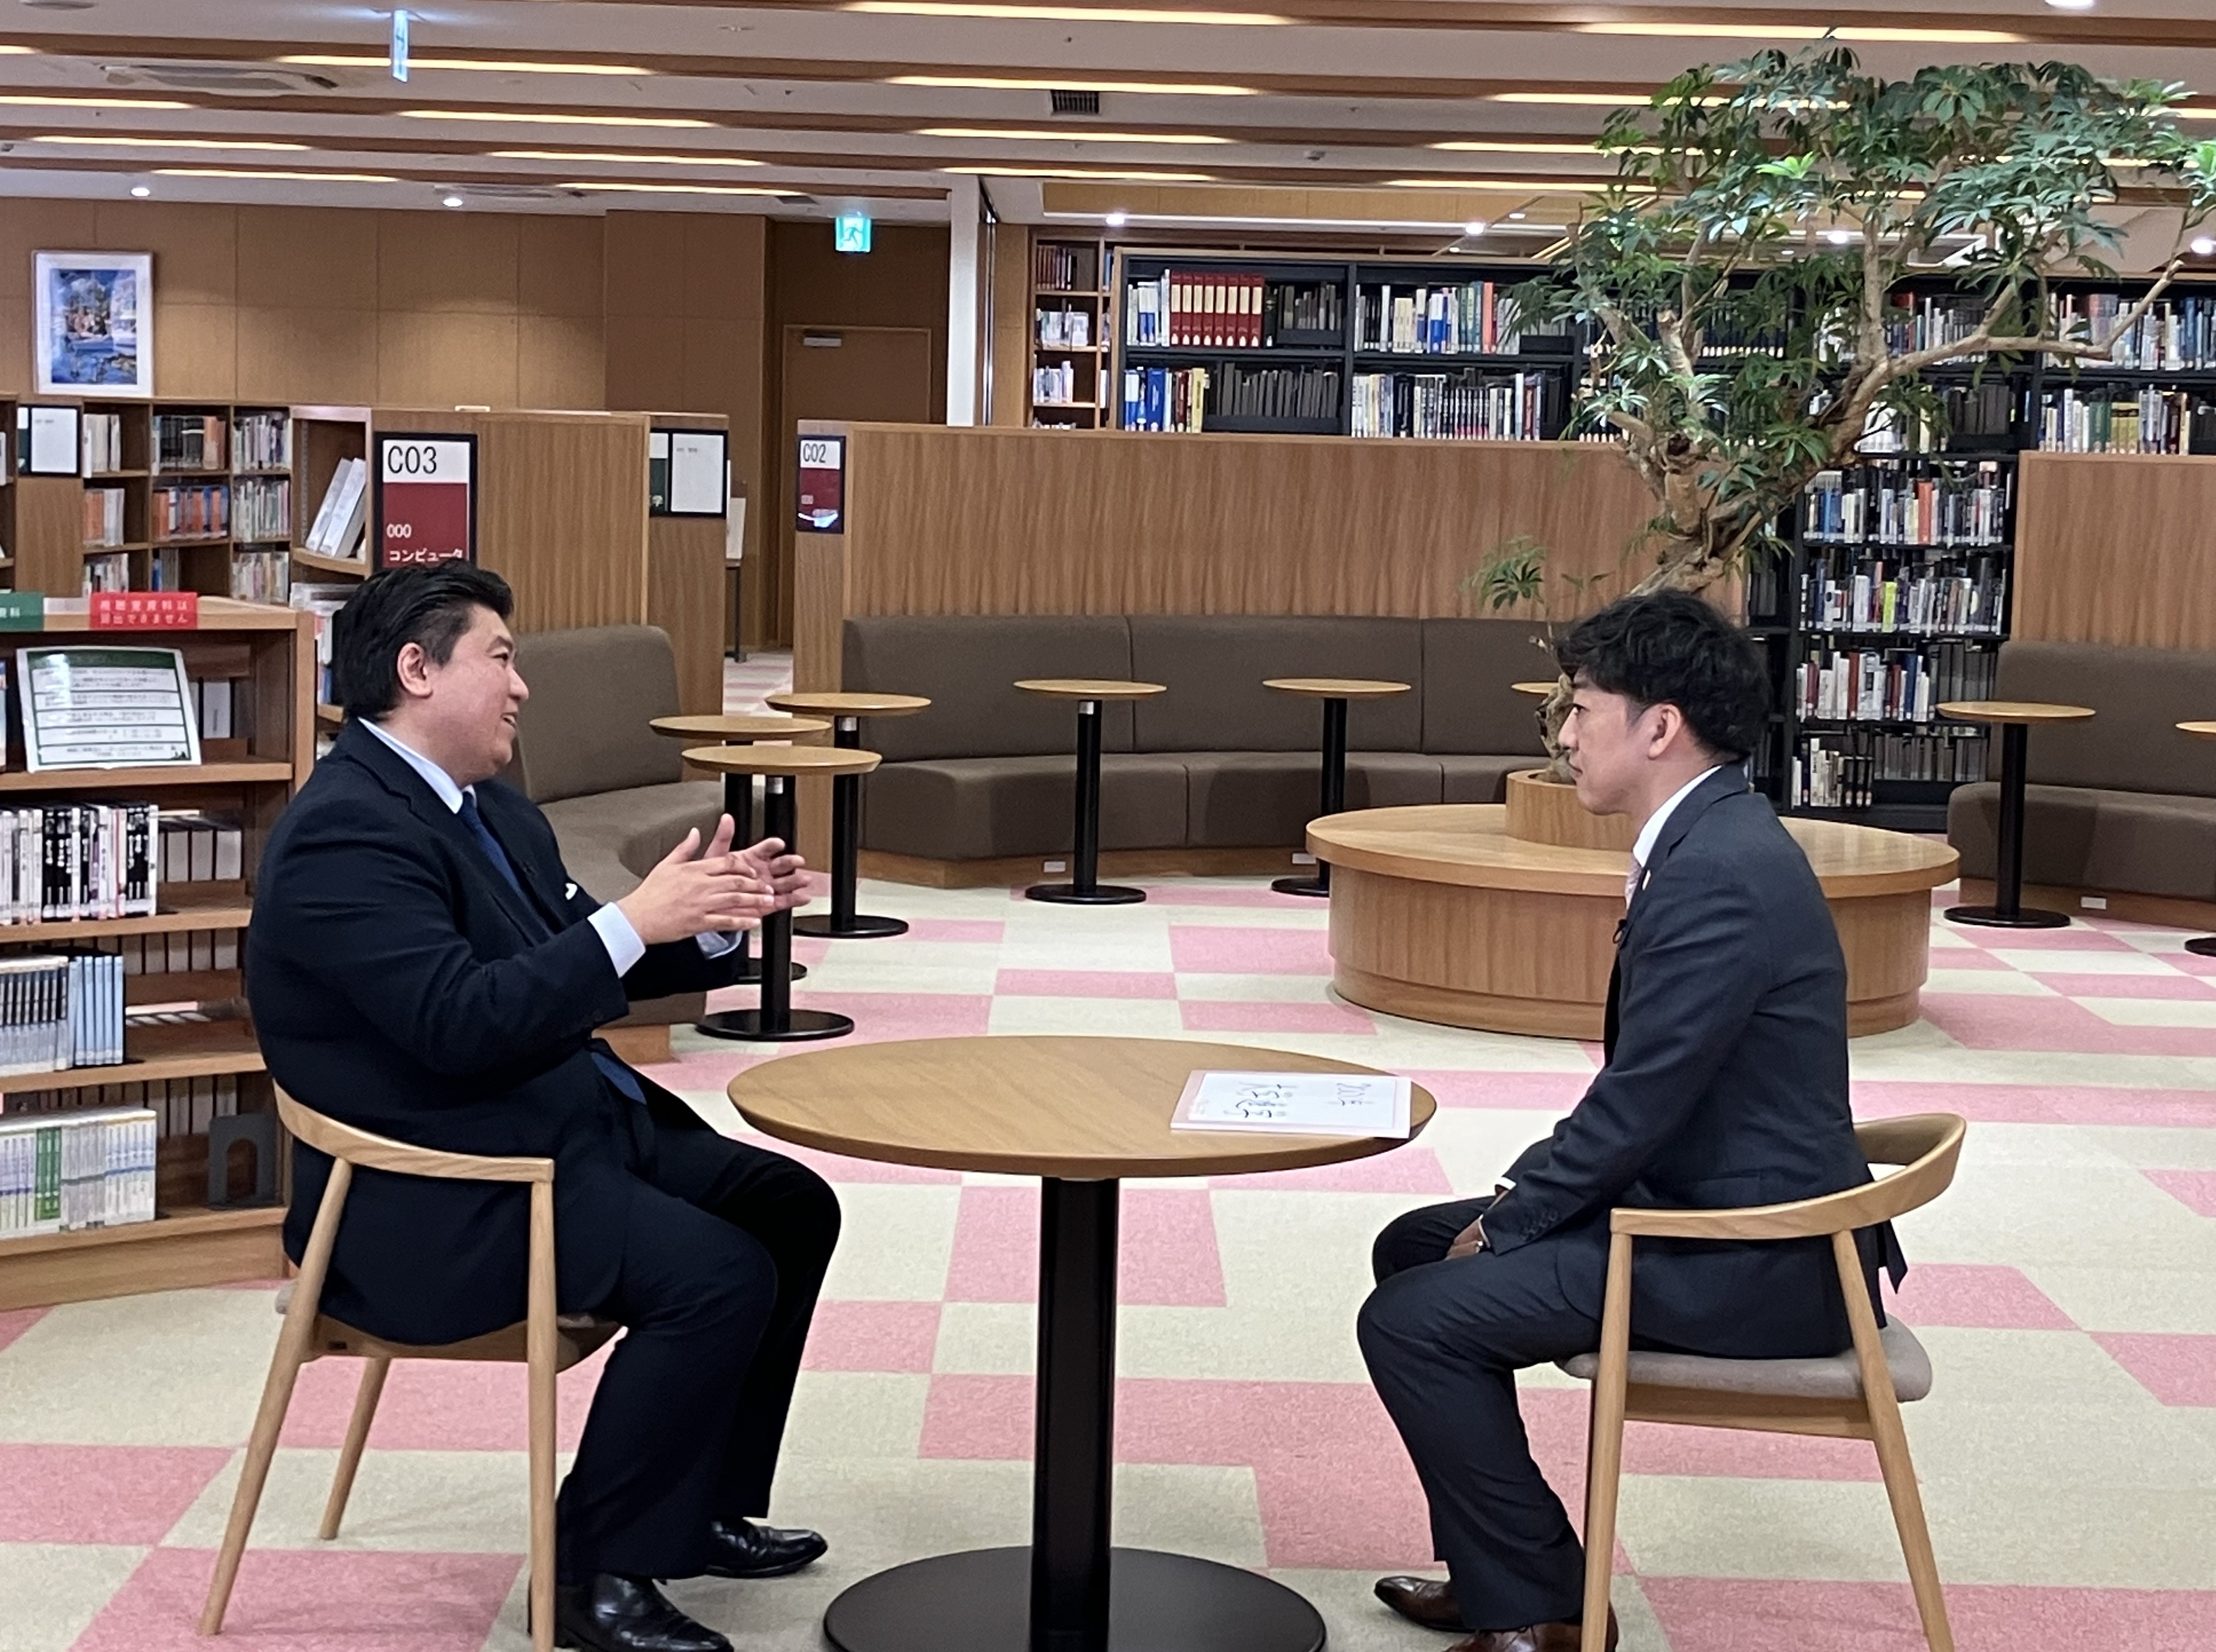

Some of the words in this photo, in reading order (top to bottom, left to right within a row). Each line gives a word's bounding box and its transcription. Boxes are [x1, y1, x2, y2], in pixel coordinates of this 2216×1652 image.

[388, 445, 437, 474] C03
[804, 443, 826, 463] C02
[386, 523, 412, 538] 000
